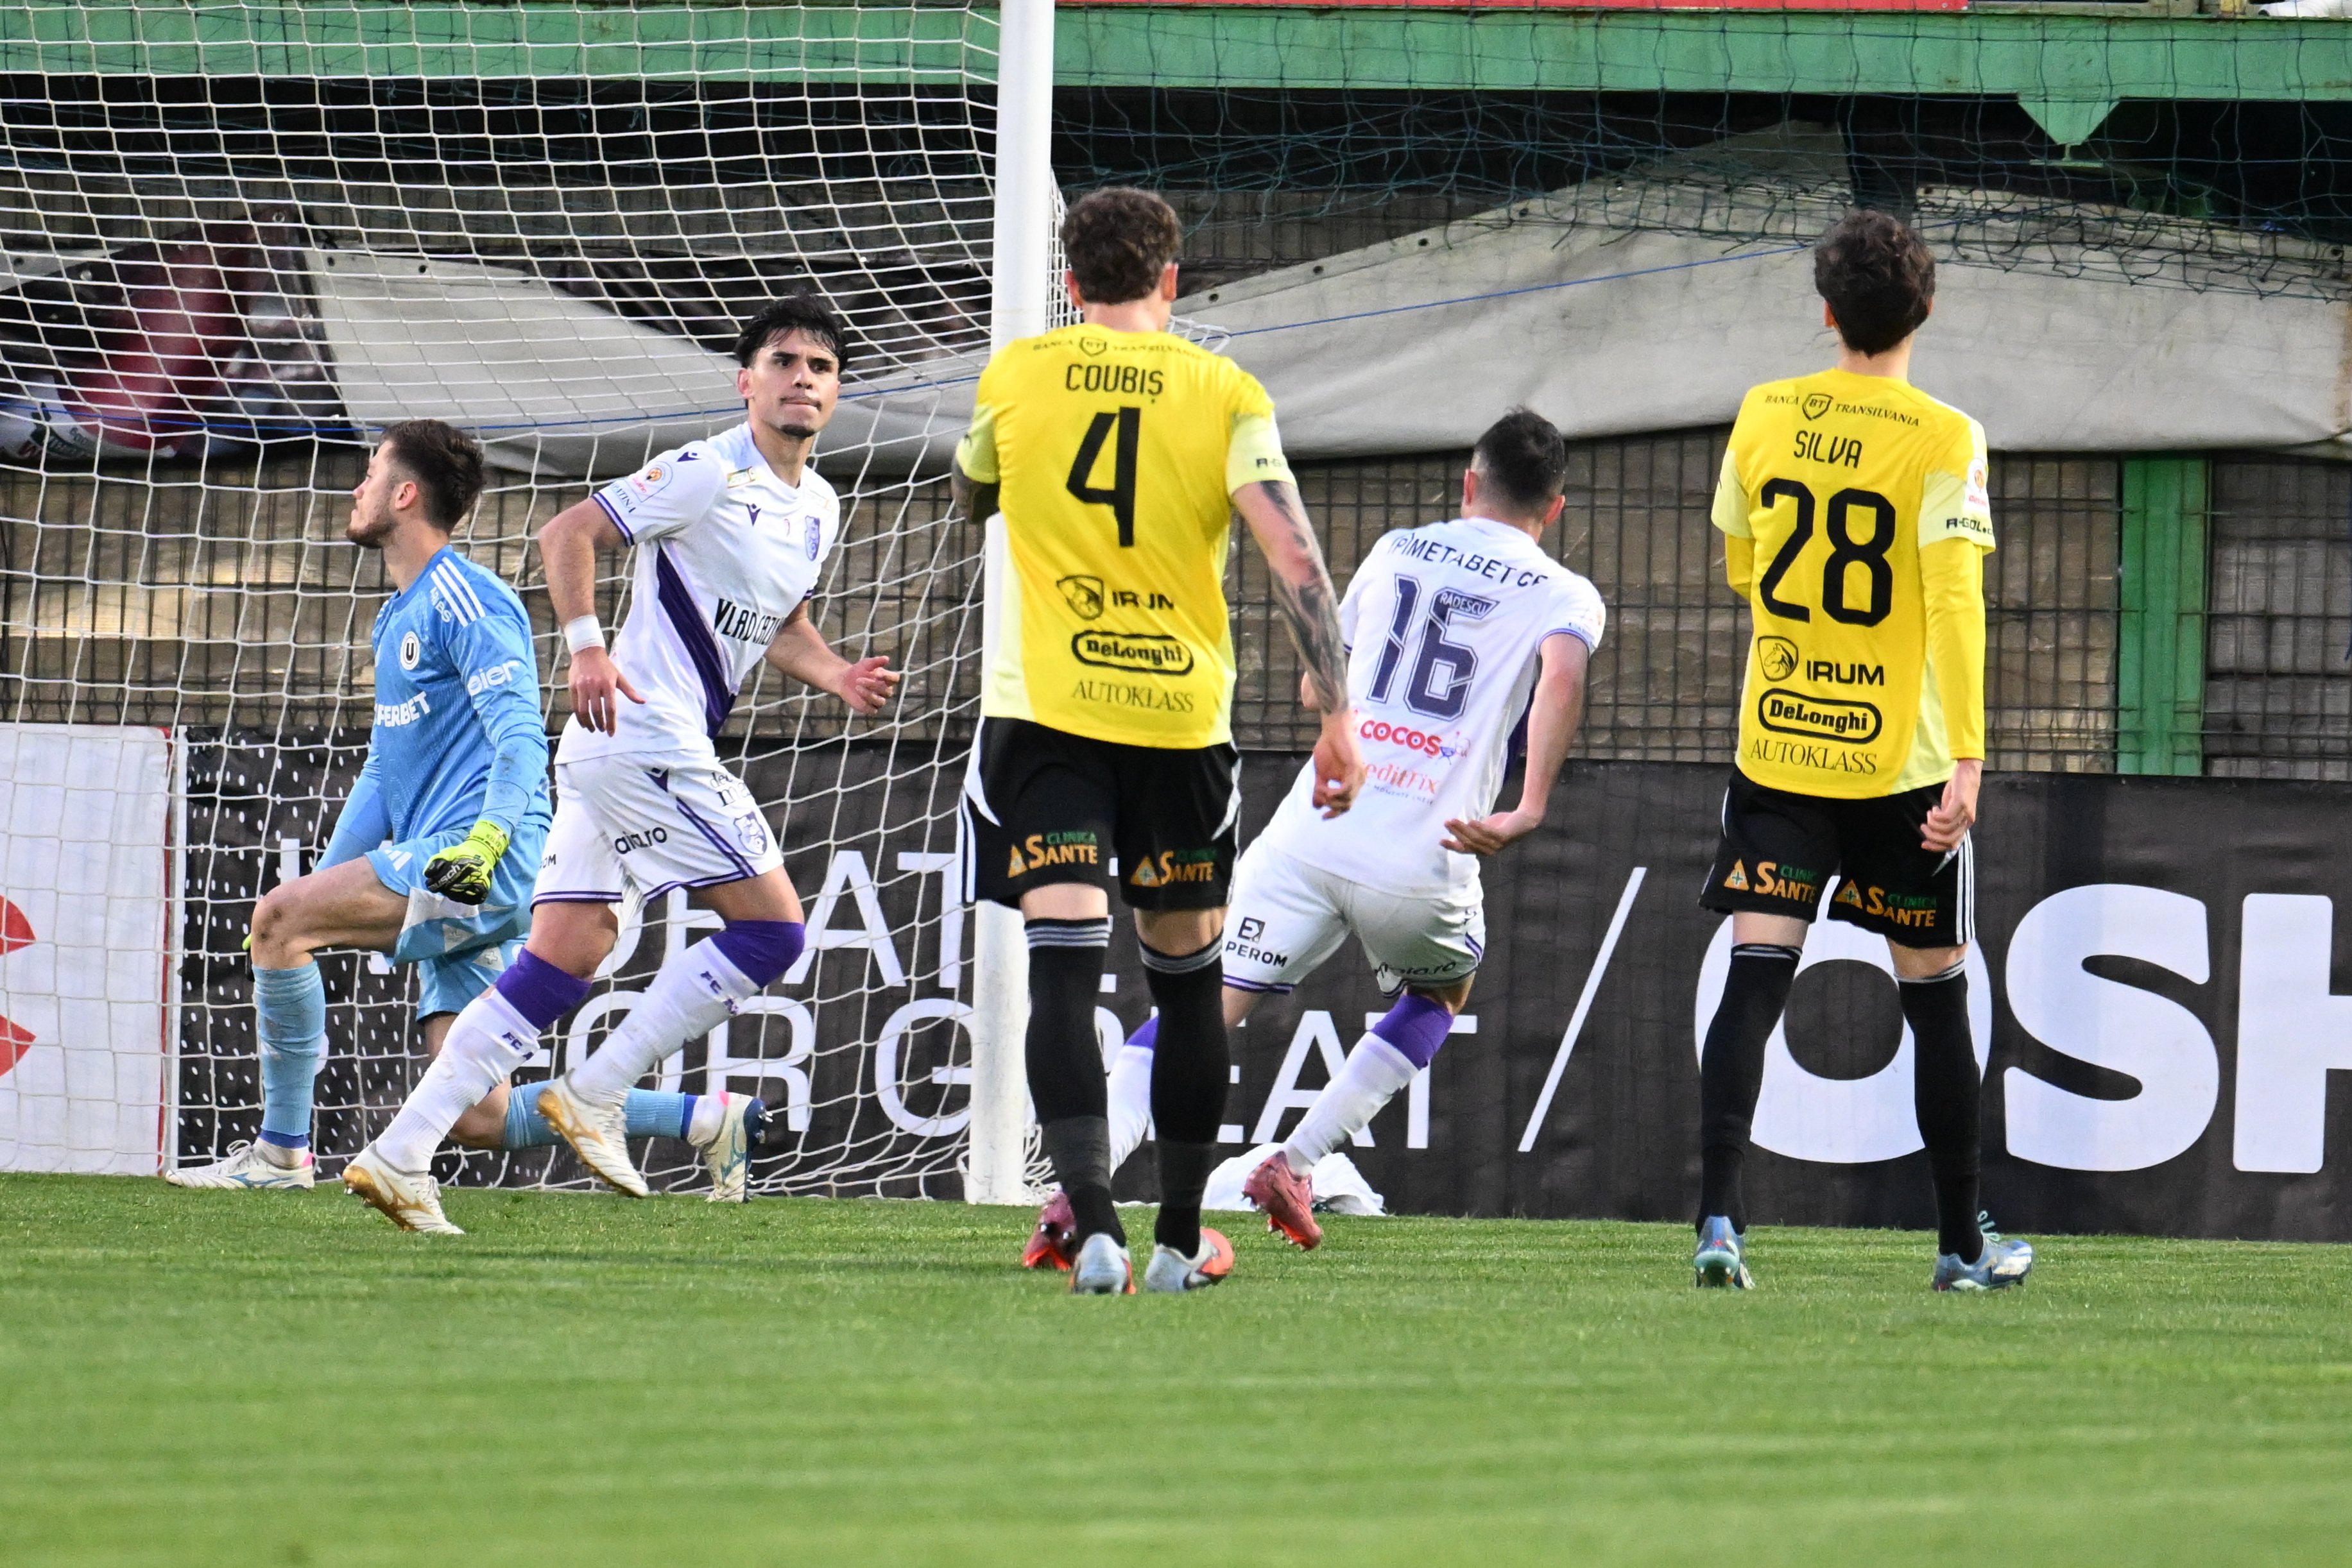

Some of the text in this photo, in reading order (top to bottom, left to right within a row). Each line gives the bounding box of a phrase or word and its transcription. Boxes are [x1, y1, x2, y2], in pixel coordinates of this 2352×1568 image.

[1765, 395, 1919, 427] BANCA BT TRANSILVANIA
[1794, 430, 1862, 469] SILVA
[1066, 406, 1140, 547] 4
[1759, 477, 1896, 628] 28
[1439, 592, 1488, 615] RADESCU
[406, 642, 415, 661] U
[1085, 640, 1183, 666] DeLonghi
[1367, 573, 1500, 722] 16
[1806, 660, 1885, 686] IRUM
[374, 691, 431, 728] PERBET
[1769, 699, 1868, 734] DeLonghi
[1750, 738, 1877, 775] AUTOKLASS
[1026, 835, 1098, 869] SANTE
[1047, 831, 1097, 845] CLINICA
[1159, 850, 1215, 885] SANTE
[1866, 885, 1936, 928] SANTE
[1225, 941, 1289, 968] PEROM
